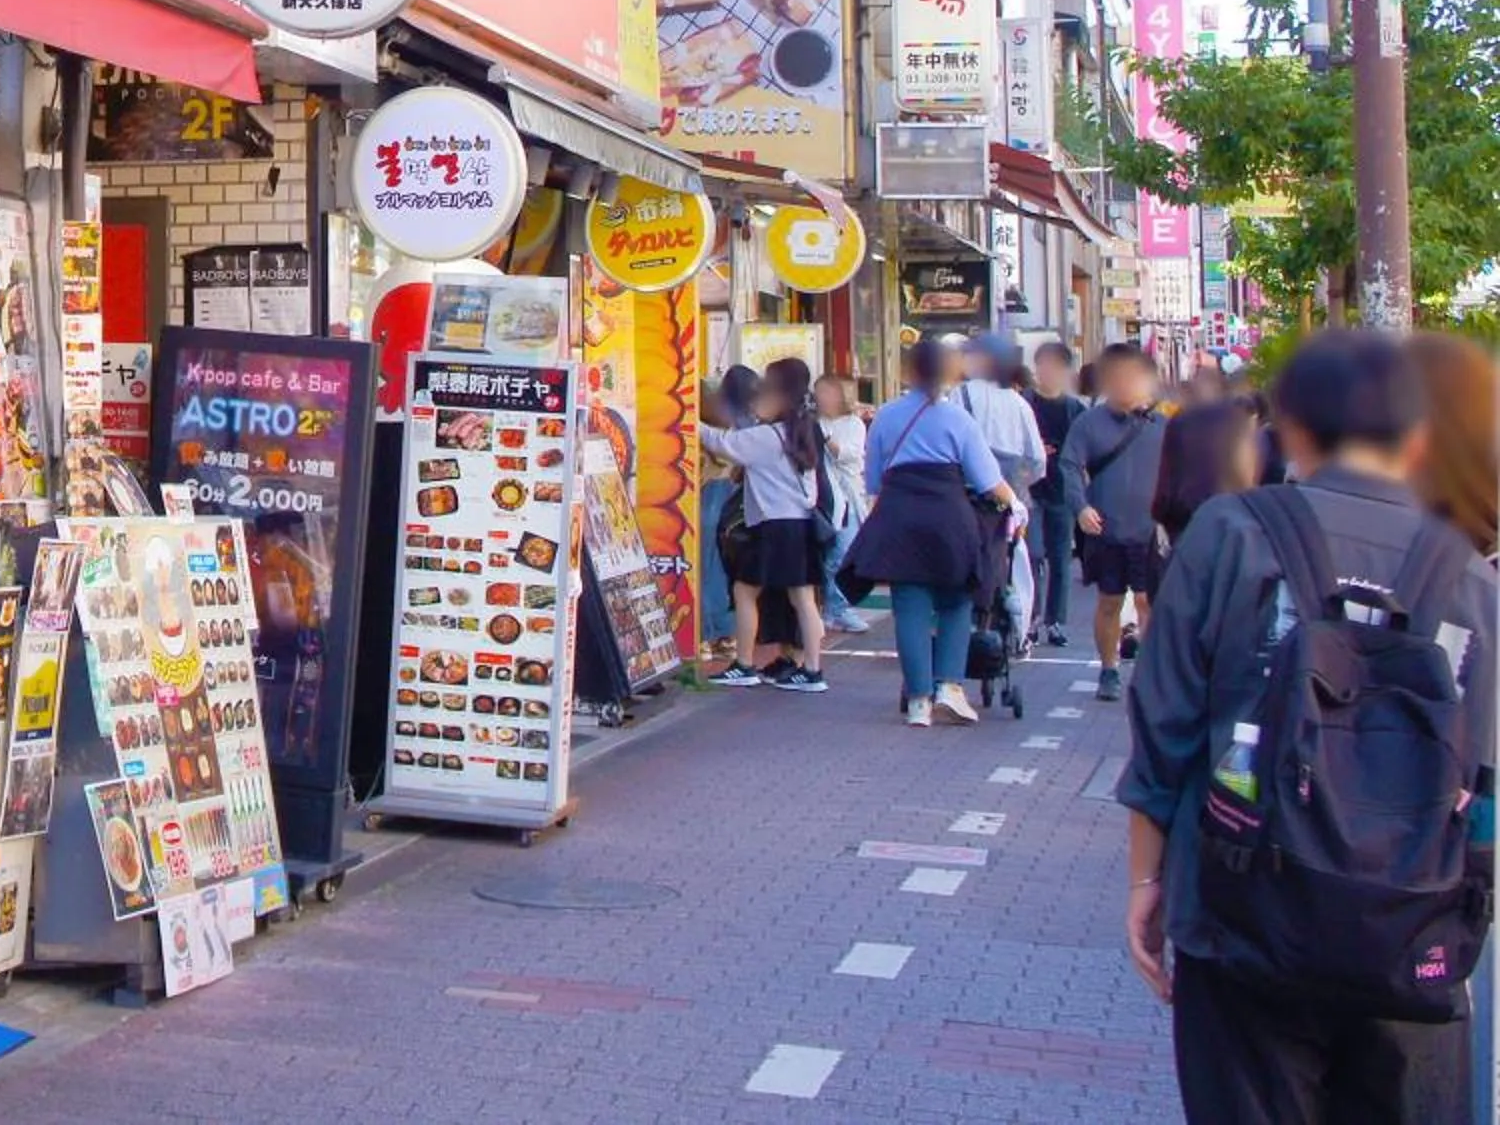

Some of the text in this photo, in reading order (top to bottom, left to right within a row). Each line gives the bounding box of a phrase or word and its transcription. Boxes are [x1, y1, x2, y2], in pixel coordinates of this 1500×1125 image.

[906, 52, 980, 70] 年中無休
[180, 98, 235, 141] 2F
[241, 369, 284, 389] cafe
[287, 373, 303, 392] &
[308, 374, 342, 394] Bar
[178, 394, 297, 437] ASTRO
